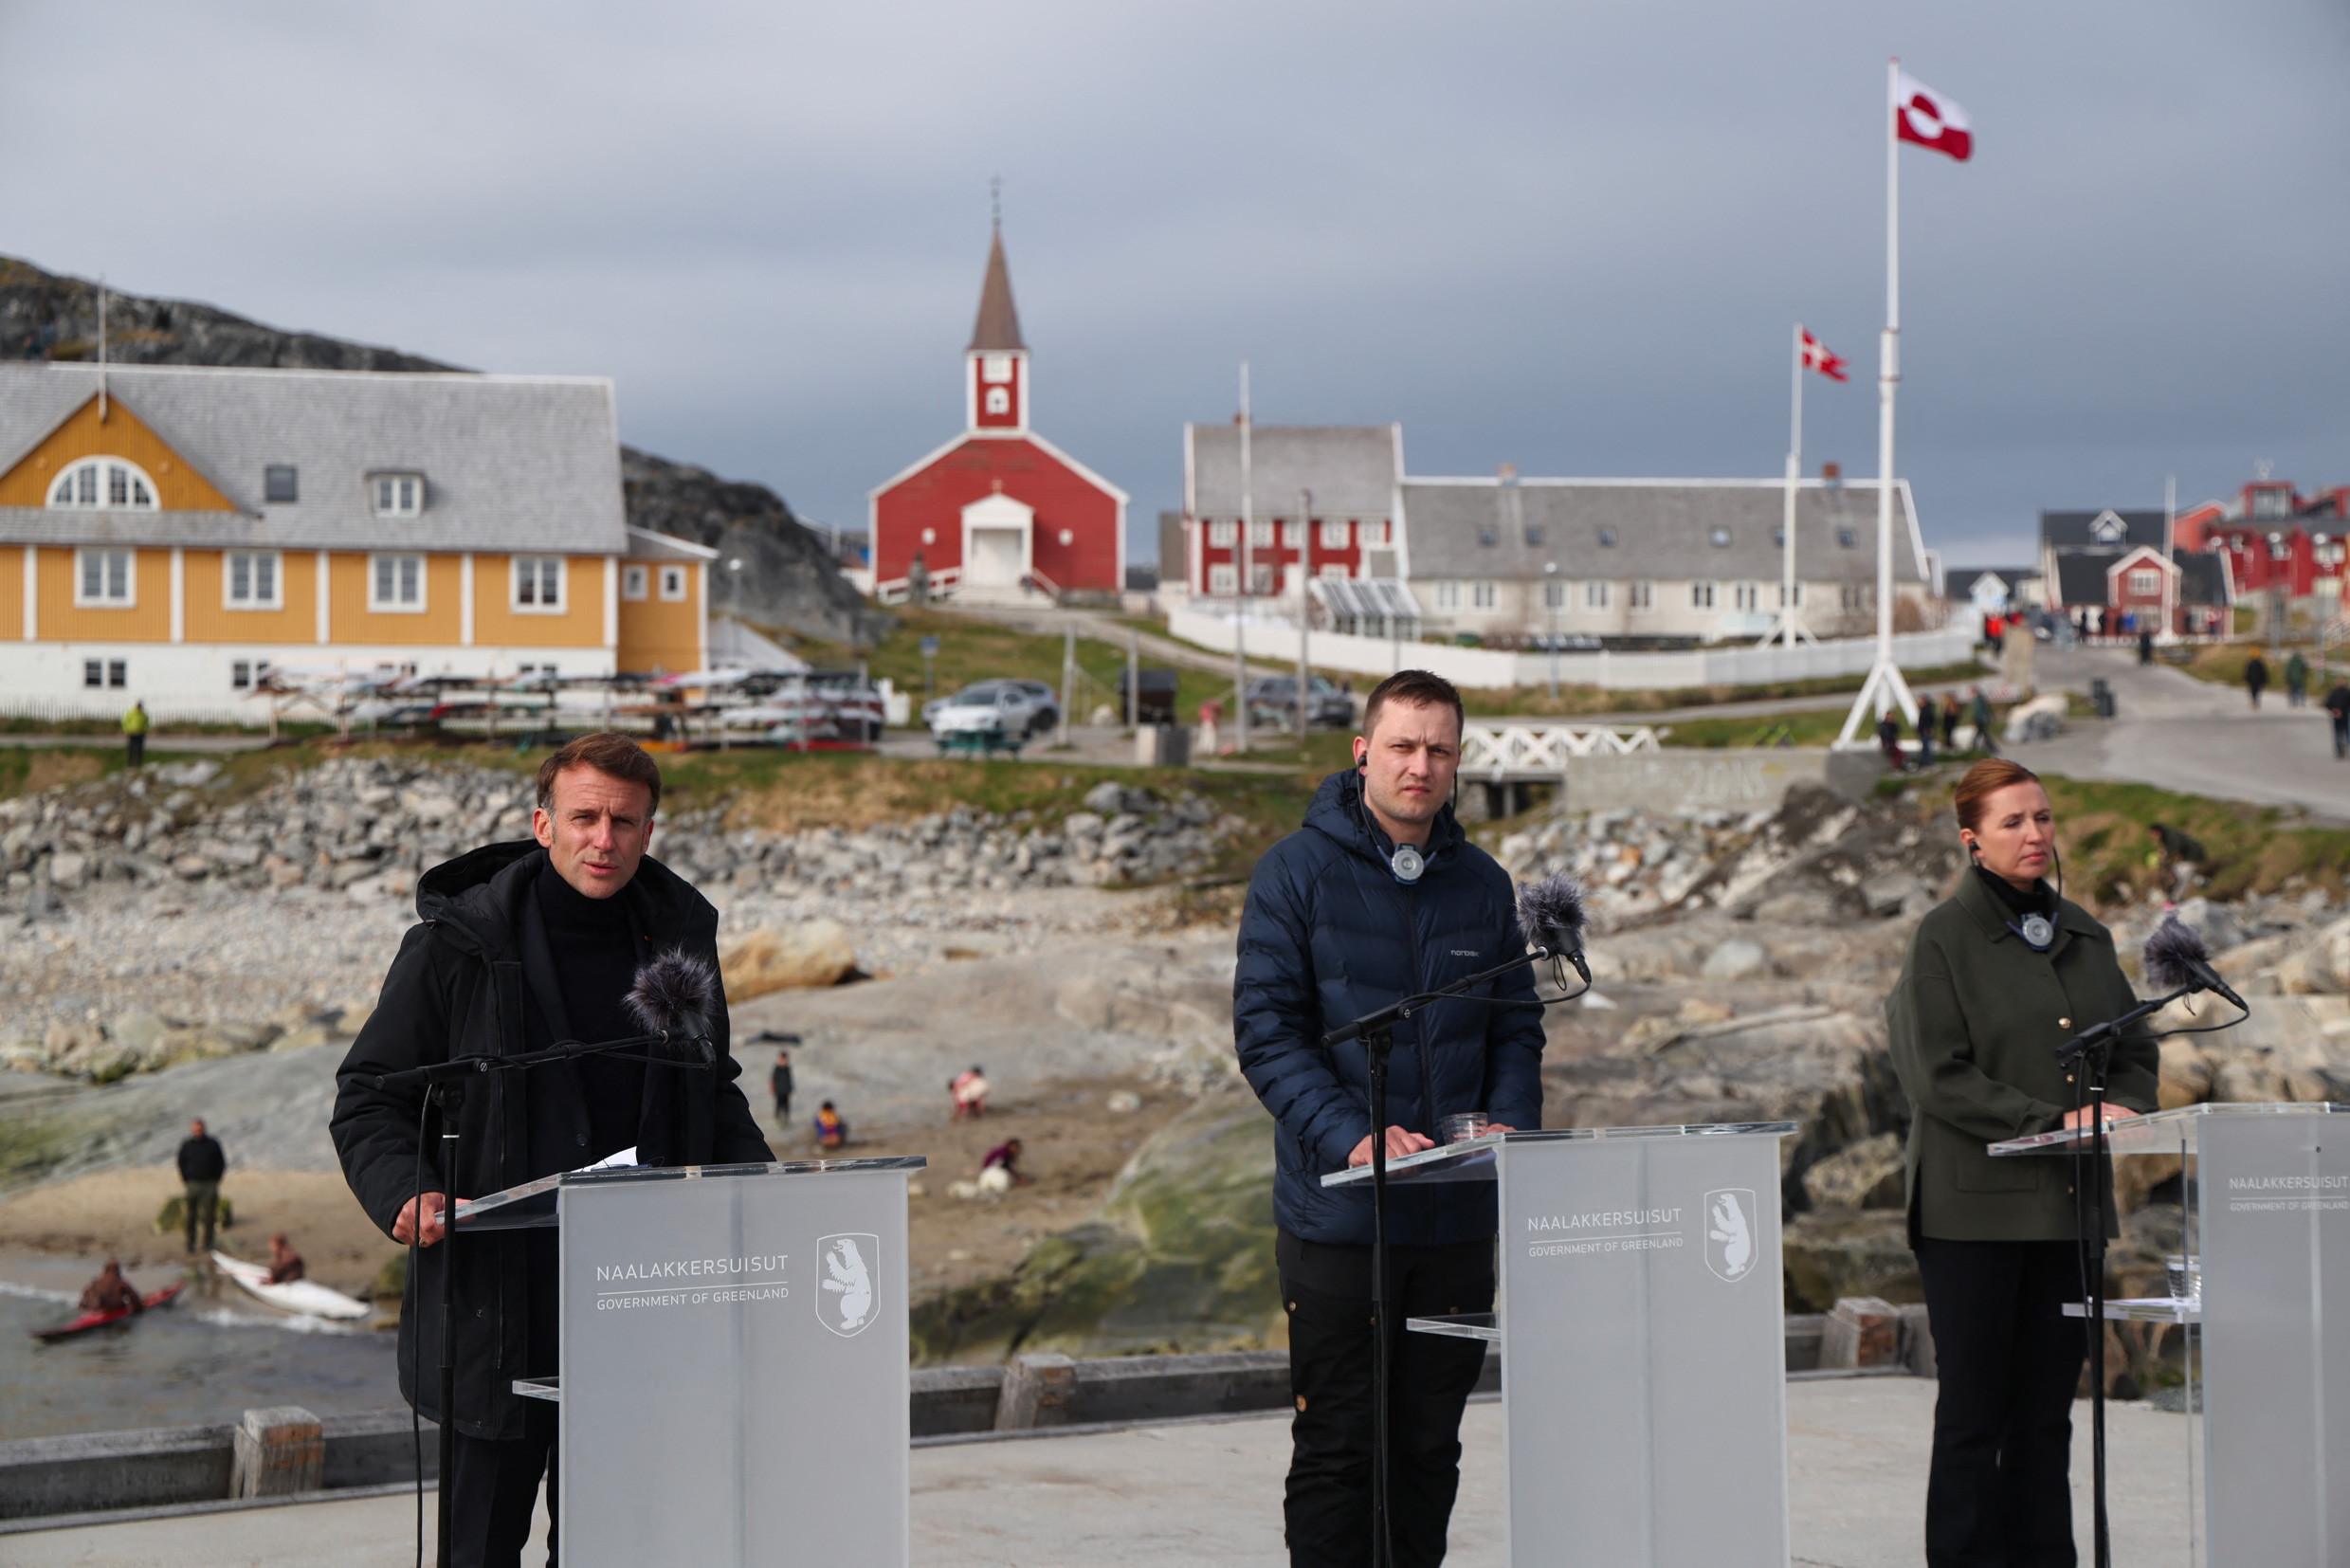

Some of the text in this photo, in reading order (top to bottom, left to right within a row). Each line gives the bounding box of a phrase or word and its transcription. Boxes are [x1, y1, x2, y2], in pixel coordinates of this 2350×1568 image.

[2229, 1176, 2349, 1190] NAALAKKERSUISUT
[2230, 1200, 2350, 1212] GOVERNMENT OF GREENLAND
[1528, 1208, 1683, 1231] NAALAKKERSUISUT
[1528, 1237, 1684, 1257] GOVERNMENT OF GREENLAND
[597, 1255, 789, 1282] NAALAKKERSUISUT
[597, 1287, 789, 1310] GOVERNMENT OF GREENLAND
